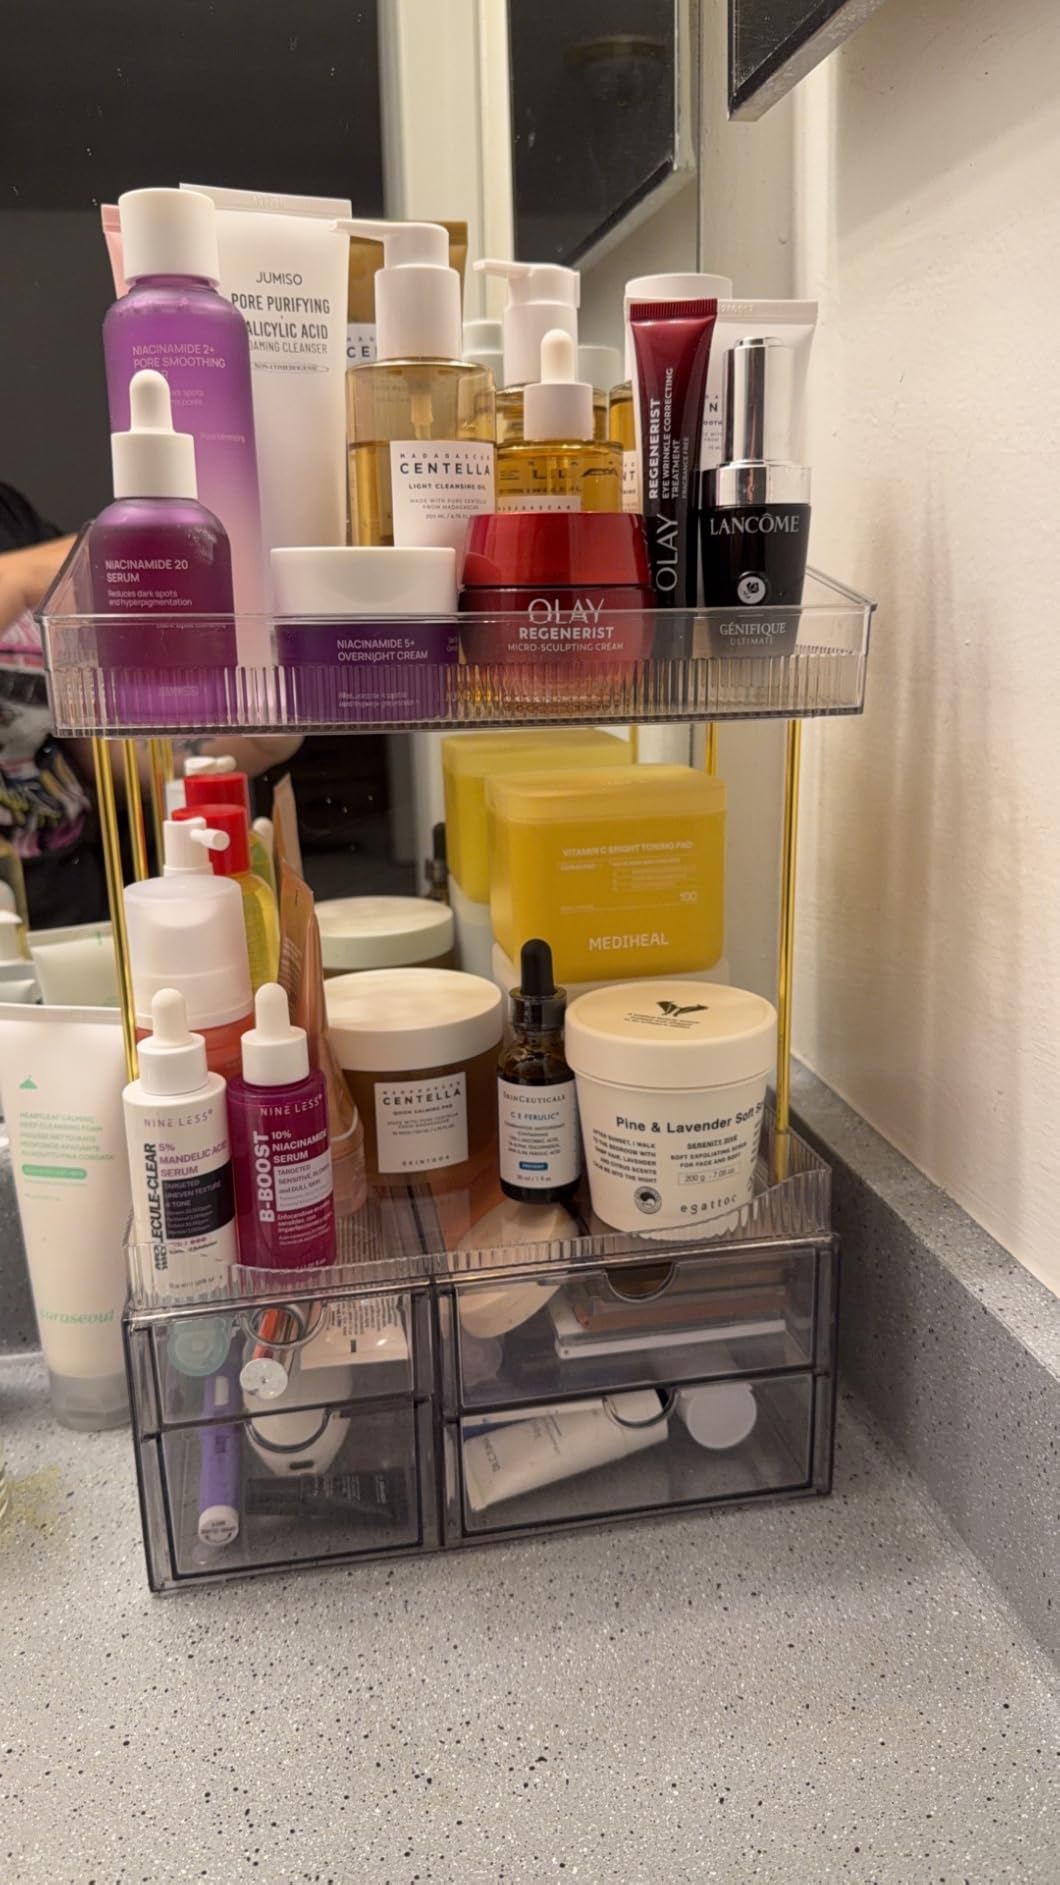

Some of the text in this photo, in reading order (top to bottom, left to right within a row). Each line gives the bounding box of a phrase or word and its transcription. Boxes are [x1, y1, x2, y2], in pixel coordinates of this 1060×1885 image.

[256, 272, 303, 286] JUMISO
[231, 293, 330, 314] PORE PURIFYING
[246, 320, 328, 340] ALICYLIC ACID
[132, 344, 201, 356] NIACINAMIDE
[282, 342, 328, 354] CLEANSER
[134, 357, 226, 369] PORE SMOOTHING
[662, 367, 673, 499] EYE WRINKLE CORRECTING
[649, 398, 661, 499] REGENERIST
[400, 462, 490, 475] CENTELLA
[671, 439, 680, 499] TREATMENT
[710, 513, 800, 536] LANCÔME
[656, 513, 679, 592] OLAY
[105, 559, 189, 570] NIACINAMIDE 20
[106, 573, 140, 583] SERUM
[528, 598, 605, 625] OLAY
[519, 626, 614, 640] REGENERIST
[719, 621, 787, 636] GÉNIFIQUE
[337, 639, 403, 650] NIACINAMIDE
[508, 642, 624, 652] MICRO-SCULPTING CREAM
[337, 650, 428, 663] OVERNIGHT CREAM
[588, 932, 669, 951] MEDIHEAL
[383, 1088, 461, 1105] CENTELLA
[260, 1105, 290, 1116] NINE
[616, 1116, 646, 1132] Pine
[651, 1122, 661, 1133] &
[667, 1117, 732, 1133] Lavender
[735, 1107, 754, 1124] Soft
[271, 1129, 292, 1140] 10%
[158, 1143, 175, 1152] 5%
[159, 1148, 212, 1165] MANDELIC
[273, 1150, 309, 1164] SERUM
[160, 1166, 198, 1178] SERUM
[253, 1130, 275, 1223] B-BOOST
